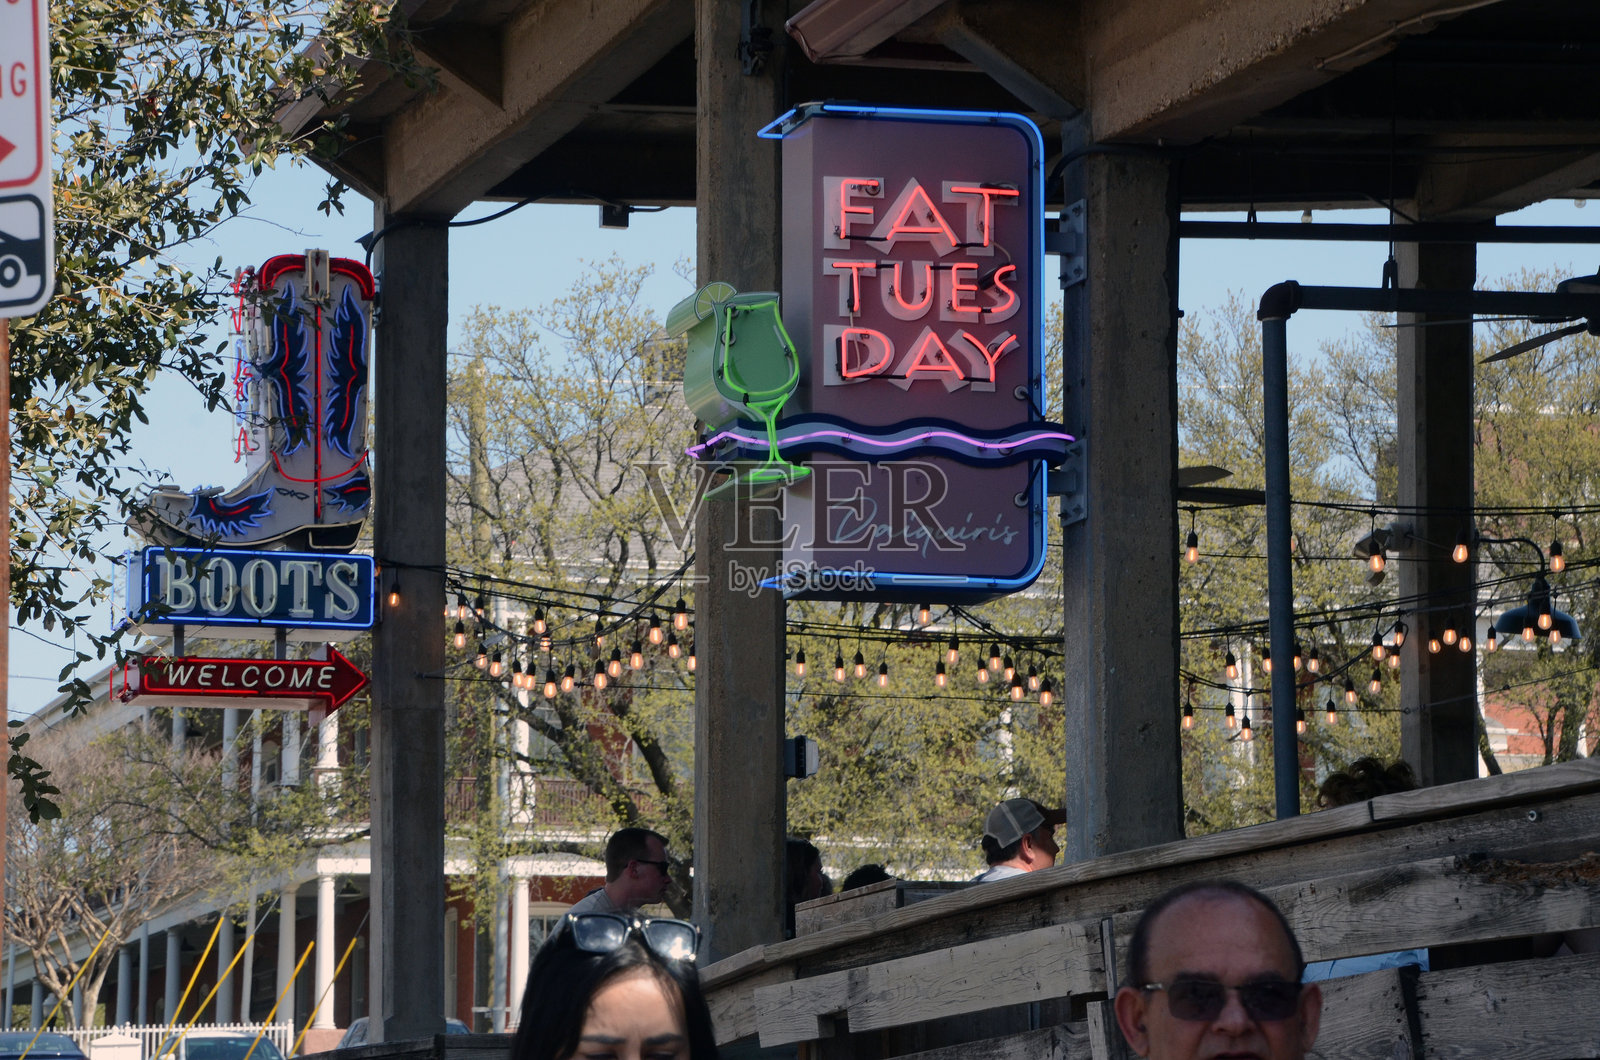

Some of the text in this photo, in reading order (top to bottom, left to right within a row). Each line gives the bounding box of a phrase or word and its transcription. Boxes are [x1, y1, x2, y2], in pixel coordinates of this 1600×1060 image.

[0, 62, 26, 98] G
[824, 176, 1019, 257] FAT
[824, 257, 1021, 325] TUES
[824, 324, 1020, 393] DAY
[832, 496, 1019, 559] Daiquiris
[156, 554, 361, 621] BOOTS
[167, 663, 336, 690] WELCOME
